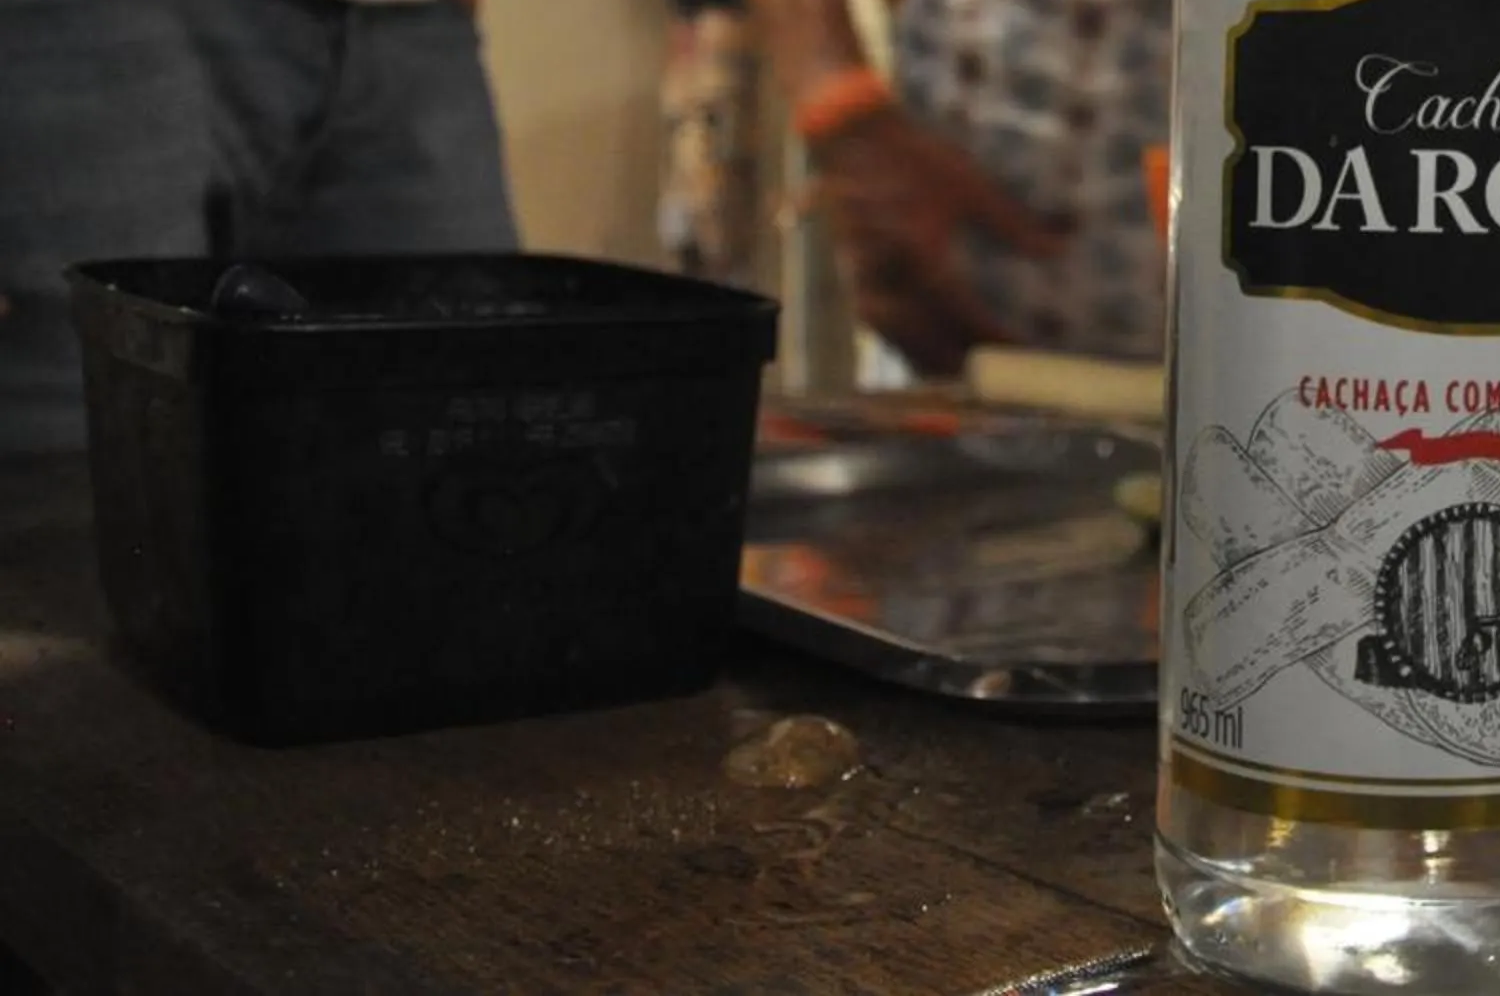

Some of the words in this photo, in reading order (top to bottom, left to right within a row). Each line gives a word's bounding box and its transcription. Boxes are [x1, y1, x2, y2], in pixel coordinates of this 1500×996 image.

[1249, 144, 1397, 233] DA
[1299, 375, 1431, 416] CACHAÇA
[1180, 686, 1210, 739] 965
[1214, 706, 1243, 749] ml
